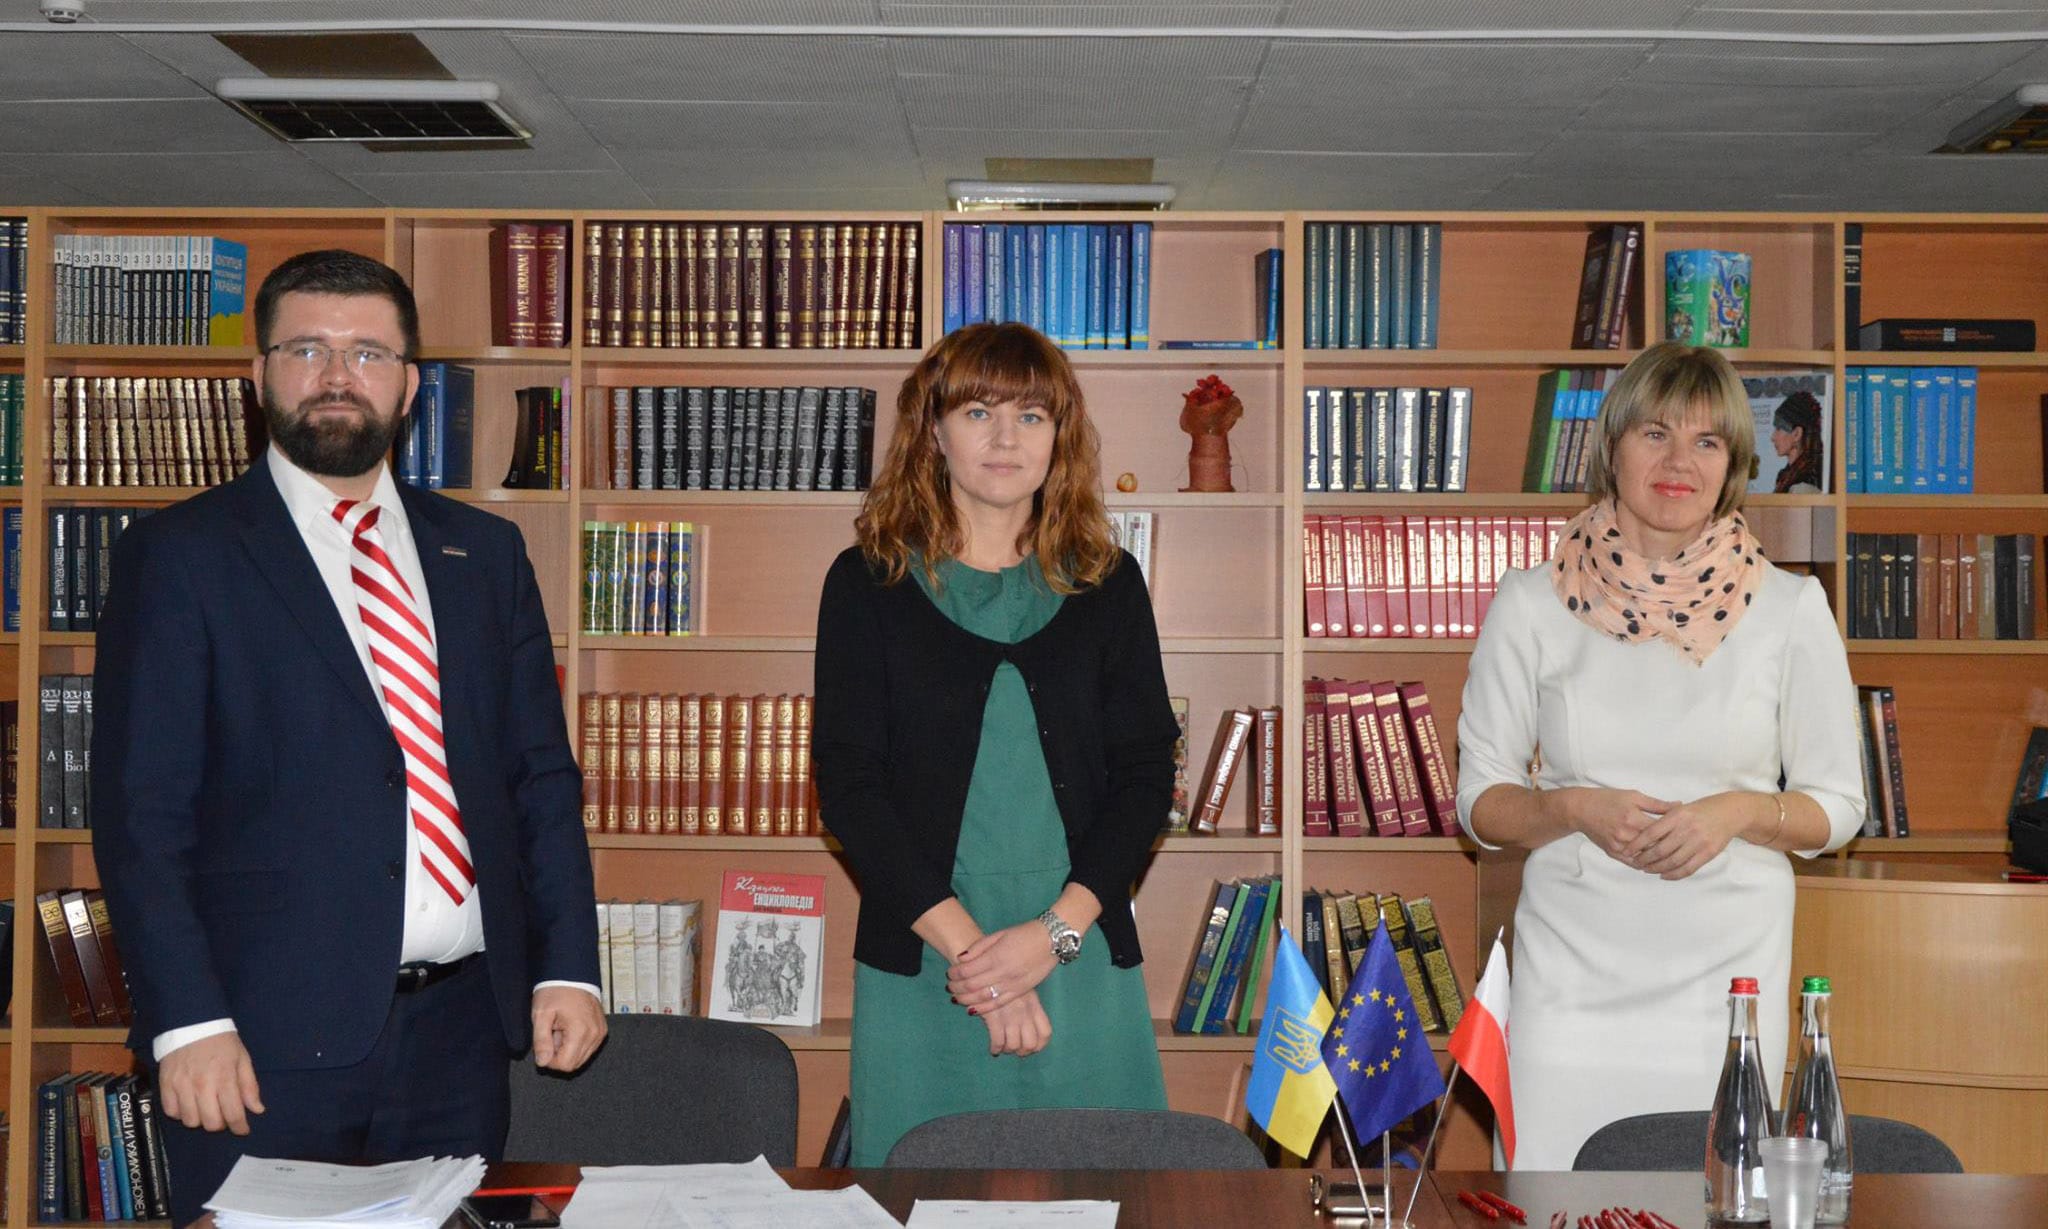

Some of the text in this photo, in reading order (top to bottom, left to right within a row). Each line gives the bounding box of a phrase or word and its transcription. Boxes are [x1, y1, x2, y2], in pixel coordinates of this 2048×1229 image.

[55, 251, 62, 261] 1
[65, 251, 72, 262] 2
[1306, 713, 1316, 802] ЗОЛОТА КНИГА
[1331, 713, 1347, 803] ЗОЛОТА КНИГА
[1356, 715, 1383, 803] ЗОЛОТА КНИГА
[1383, 715, 1409, 802] ЗОЛОТА КНИГА
[1415, 717, 1446, 803] ЗОЛОТА КНИГА
[119, 1092, 146, 1210] ЭКОНОМИКА И ПРАВО
